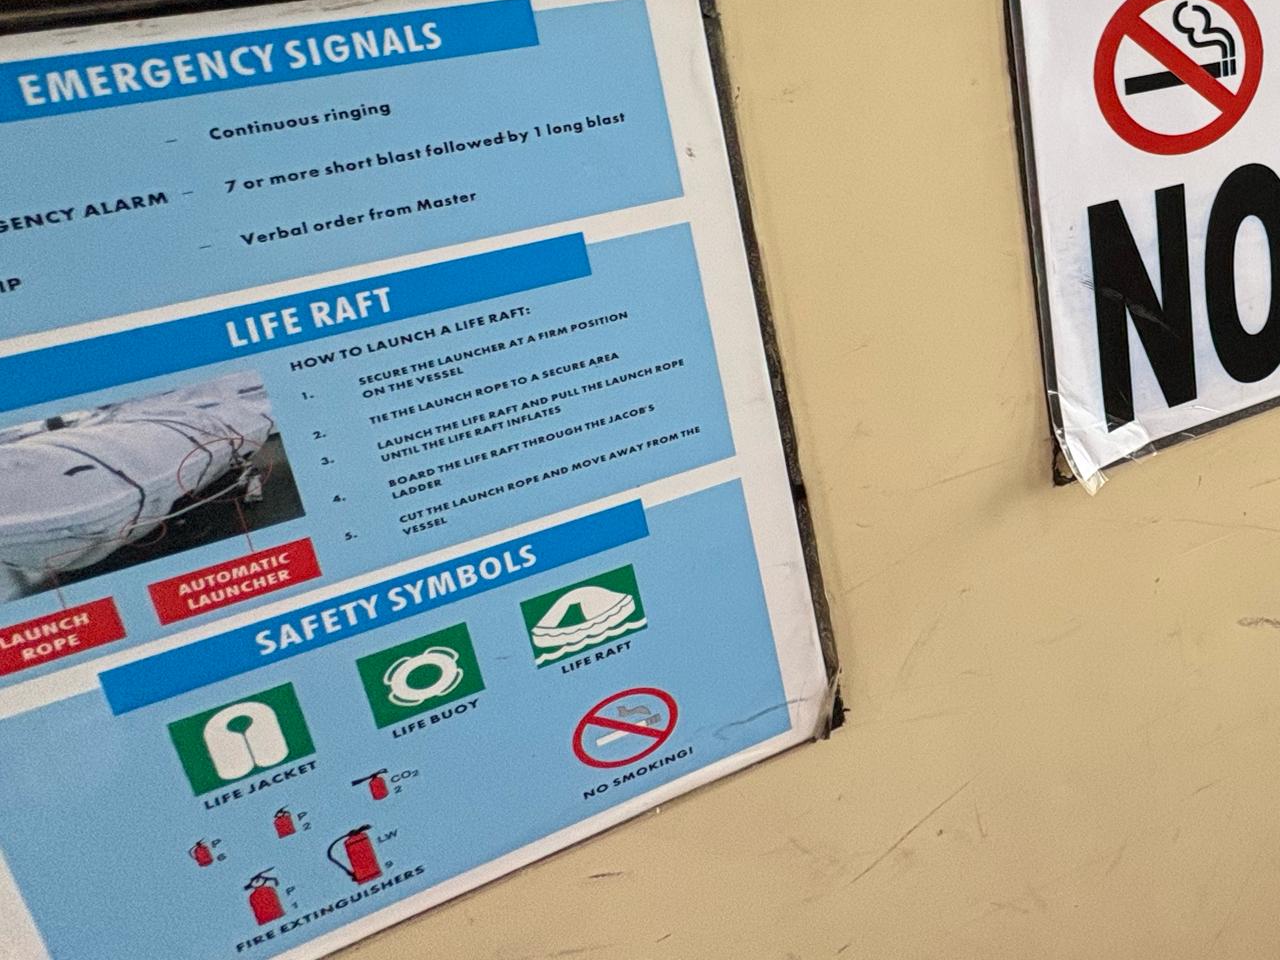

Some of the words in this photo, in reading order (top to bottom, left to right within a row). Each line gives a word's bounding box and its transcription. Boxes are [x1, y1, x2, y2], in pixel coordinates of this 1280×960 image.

[18, 43, 274, 106] EMERGENCY
[284, 22, 442, 69] SIGNALS
[209, 116, 319, 140] Continuous
[324, 103, 391, 122] ringing
[225, 179, 236, 193] 7
[243, 178, 264, 190] or
[270, 168, 320, 185] more
[325, 156, 372, 175] short
[376, 148, 421, 167] blast
[425, 131, 503, 157] followed
[507, 129, 529, 144] by
[534, 125, 542, 138] 1
[546, 122, 583, 137] long
[585, 112, 625, 129] blast
[0, 207, 75, 233] GENCY
[84, 192, 169, 218] ALARM
[240, 222, 308, 246] Verbal
[313, 213, 365, 232] order
[368, 205, 412, 221] from
[417, 192, 476, 212] Master
[225, 307, 302, 348] LIFE
[309, 286, 391, 328] RAFT
[290, 352, 335, 372] HOW
[339, 346, 363, 360] TO
[366, 328, 436, 353] LAUNCH
[440, 325, 452, 336] A
[455, 316, 486, 332] LIFE
[489, 306, 531, 324] RAFT:
[358, 366, 409, 386] SECURE
[409, 359, 436, 373] THE
[437, 342, 506, 366] LAUNCHER
[508, 337, 524, 349] AT
[527, 334, 537, 344] A
[538, 326, 568, 341] FIRM
[570, 311, 629, 332] POSITION
[301, 391, 315, 400] 1.
[362, 385, 386, 399] ON
[388, 378, 414, 392] THE
[416, 366, 464, 385] VESSEL
[369, 411, 389, 425] TIE
[390, 405, 416, 420] THE
[418, 391, 473, 412] LAUNCH
[475, 380, 509, 397] ROPE
[510, 376, 528, 388] TO
[530, 373, 540, 383] A
[542, 360, 586, 379] SECURE
[588, 352, 620, 367] AREA
[377, 428, 433, 450] LAUNCH
[434, 421, 459, 434] THE
[461, 413, 486, 428] LIFE
[488, 405, 518, 420] RAFT
[521, 396, 548, 411] AND
[551, 387, 580, 402] PULL
[581, 380, 603, 394] THE
[605, 367, 653, 388] LAUNCH
[655, 358, 685, 374] ROPE
[312, 430, 327, 440] 2.
[380, 447, 421, 463] UNTIL
[421, 438, 446, 452] THE
[447, 430, 473, 445] LIFE
[474, 421, 504, 437] RAFT
[507, 405, 562, 428] INFLATES
[388, 467, 436, 488] BOARD
[437, 460, 462, 474] THE
[463, 451, 489, 466] LIFE
[490, 443, 520, 458] RAFT
[521, 424, 583, 449] THROUGH
[584, 418, 606, 431] THE
[608, 403, 655, 424] JACOB'S
[320, 456, 335, 466] 3.
[399, 510, 424, 524] CUT
[425, 502, 450, 516] THE
[452, 485, 504, 508] LAUNCH
[507, 474, 540, 491] ROPE
[542, 466, 569, 481] AND
[571, 454, 607, 472] MOVE
[608, 442, 644, 461] AWAY
[646, 432, 679, 449] FROM
[680, 425, 701, 439] THE
[392, 479, 443, 500] LADDER
[344, 531, 358, 541] 5.
[402, 517, 448, 536] VESSEL
[178, 552, 291, 597] AUTOMATIC
[187, 569, 292, 610] LAUNCHER
[255, 594, 379, 656] SAFETY
[387, 544, 537, 611] SYMBOLS
[0, 612, 90, 649] LAUNCH
[21, 634, 81, 661] ROPE
[561, 656, 593, 674] LIFE
[594, 640, 633, 663] RAFT
[392, 718, 428, 739] LIFE
[430, 697, 480, 725] BUOY
[204, 791, 243, 810] LIFE
[248, 760, 318, 794] JACKET
[583, 783, 609, 800] NO
[612, 746, 694, 788] SMOKING!
[236, 930, 276, 953] FIRE
[280, 865, 425, 935] EXTINGUISHERS
